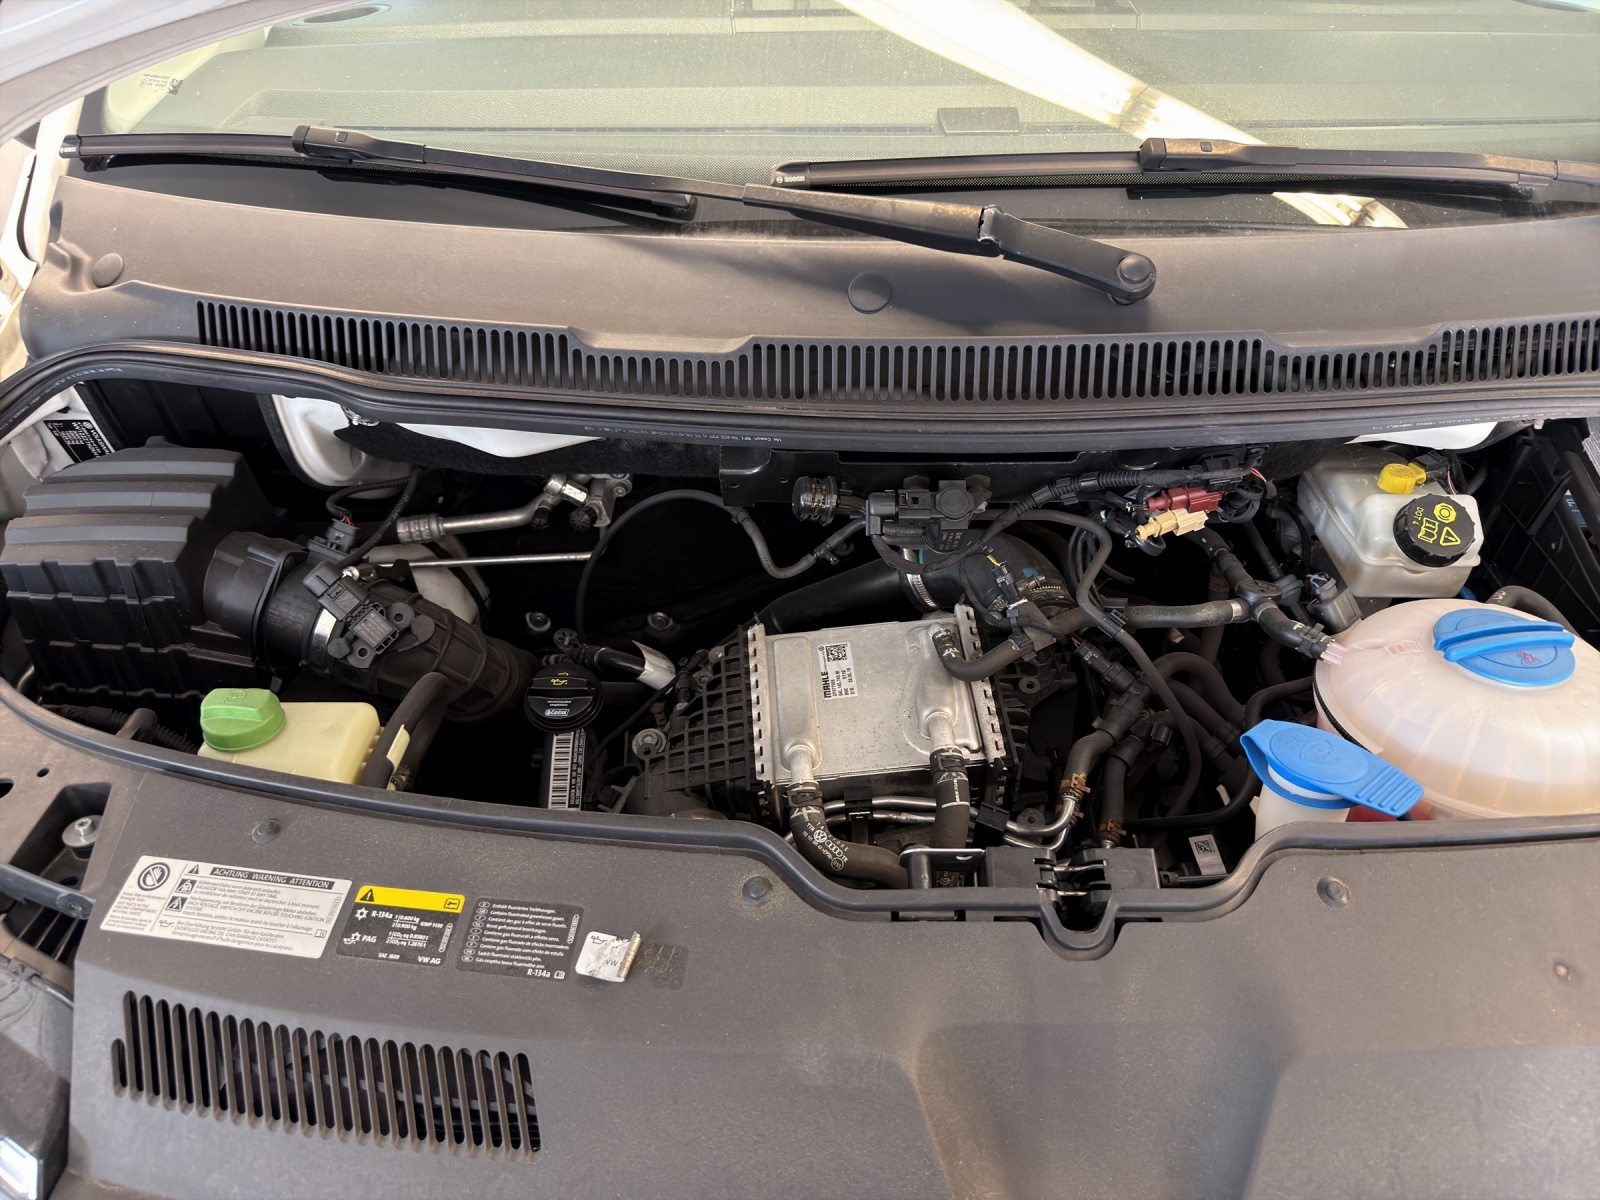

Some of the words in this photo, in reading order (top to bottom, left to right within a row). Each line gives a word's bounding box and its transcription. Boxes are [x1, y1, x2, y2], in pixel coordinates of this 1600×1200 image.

[1414, 506, 1424, 521] DOT
[821, 671, 832, 698] MAHLE
[213, 867, 250, 878] ACHTUNG
[251, 872, 287, 883] WARNING
[289, 877, 330, 888] ATTENTION
[370, 909, 394, 919] R-134a
[416, 955, 431, 963] VW
[606, 958, 619, 967] VW
[526, 968, 551, 977] R-134a
